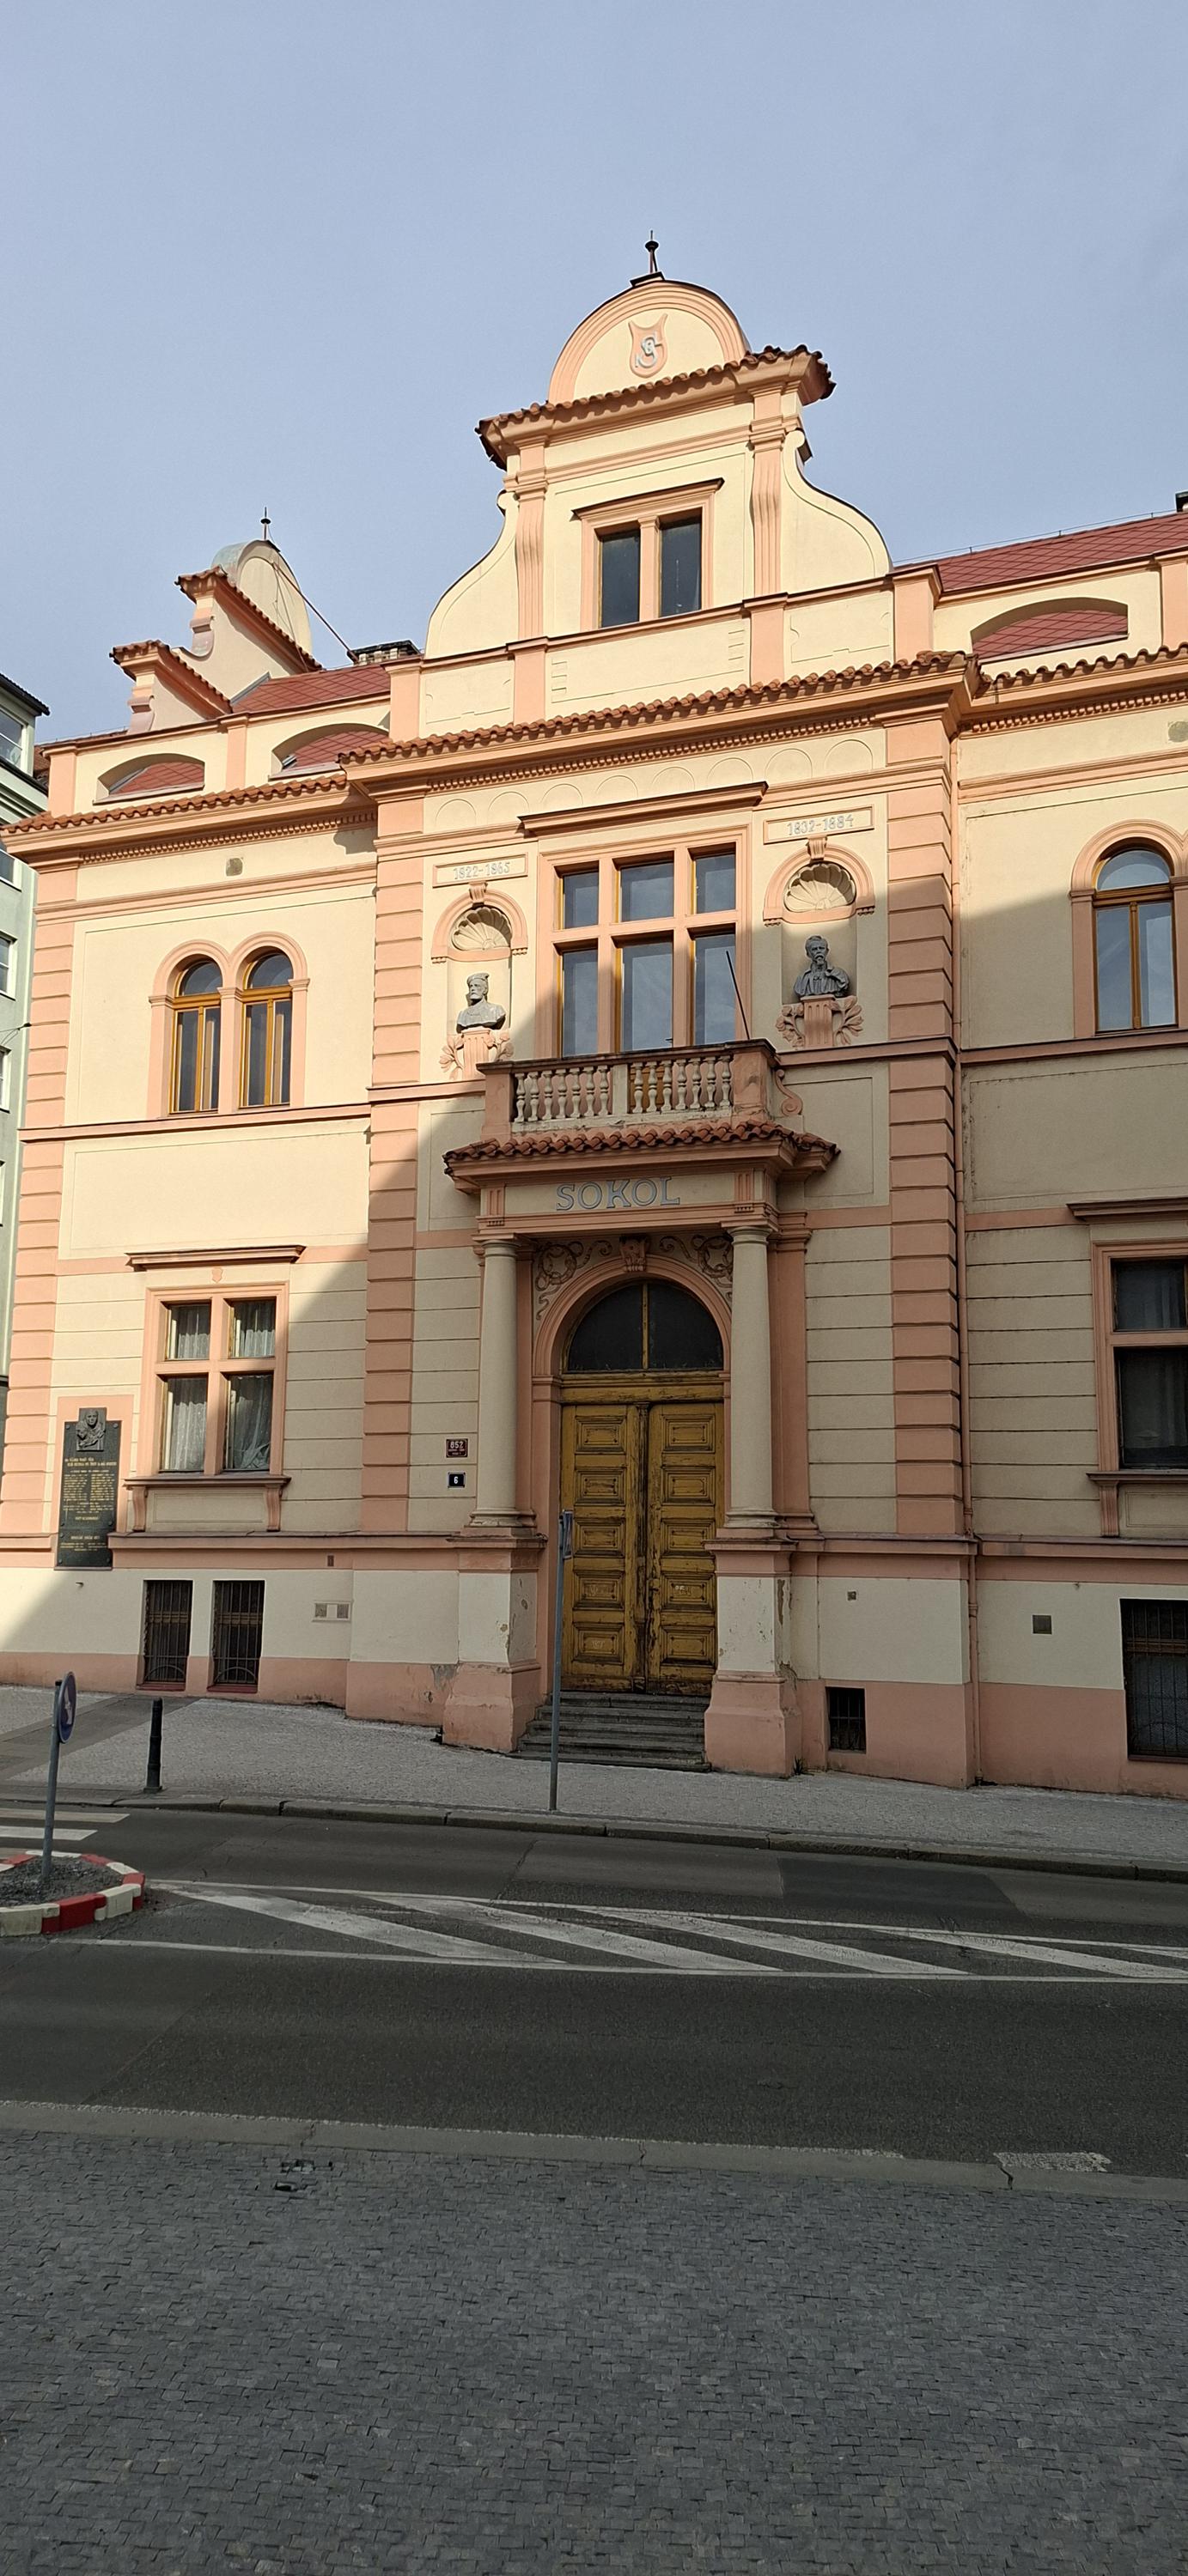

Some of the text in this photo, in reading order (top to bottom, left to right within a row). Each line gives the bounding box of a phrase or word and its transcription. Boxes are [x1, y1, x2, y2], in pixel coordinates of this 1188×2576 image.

[787, 814, 854, 835] 1832-1884
[556, 1176, 680, 1212] SOKOL
[449, 1441, 464, 1449] 852
[454, 1476, 459, 1485] 6
